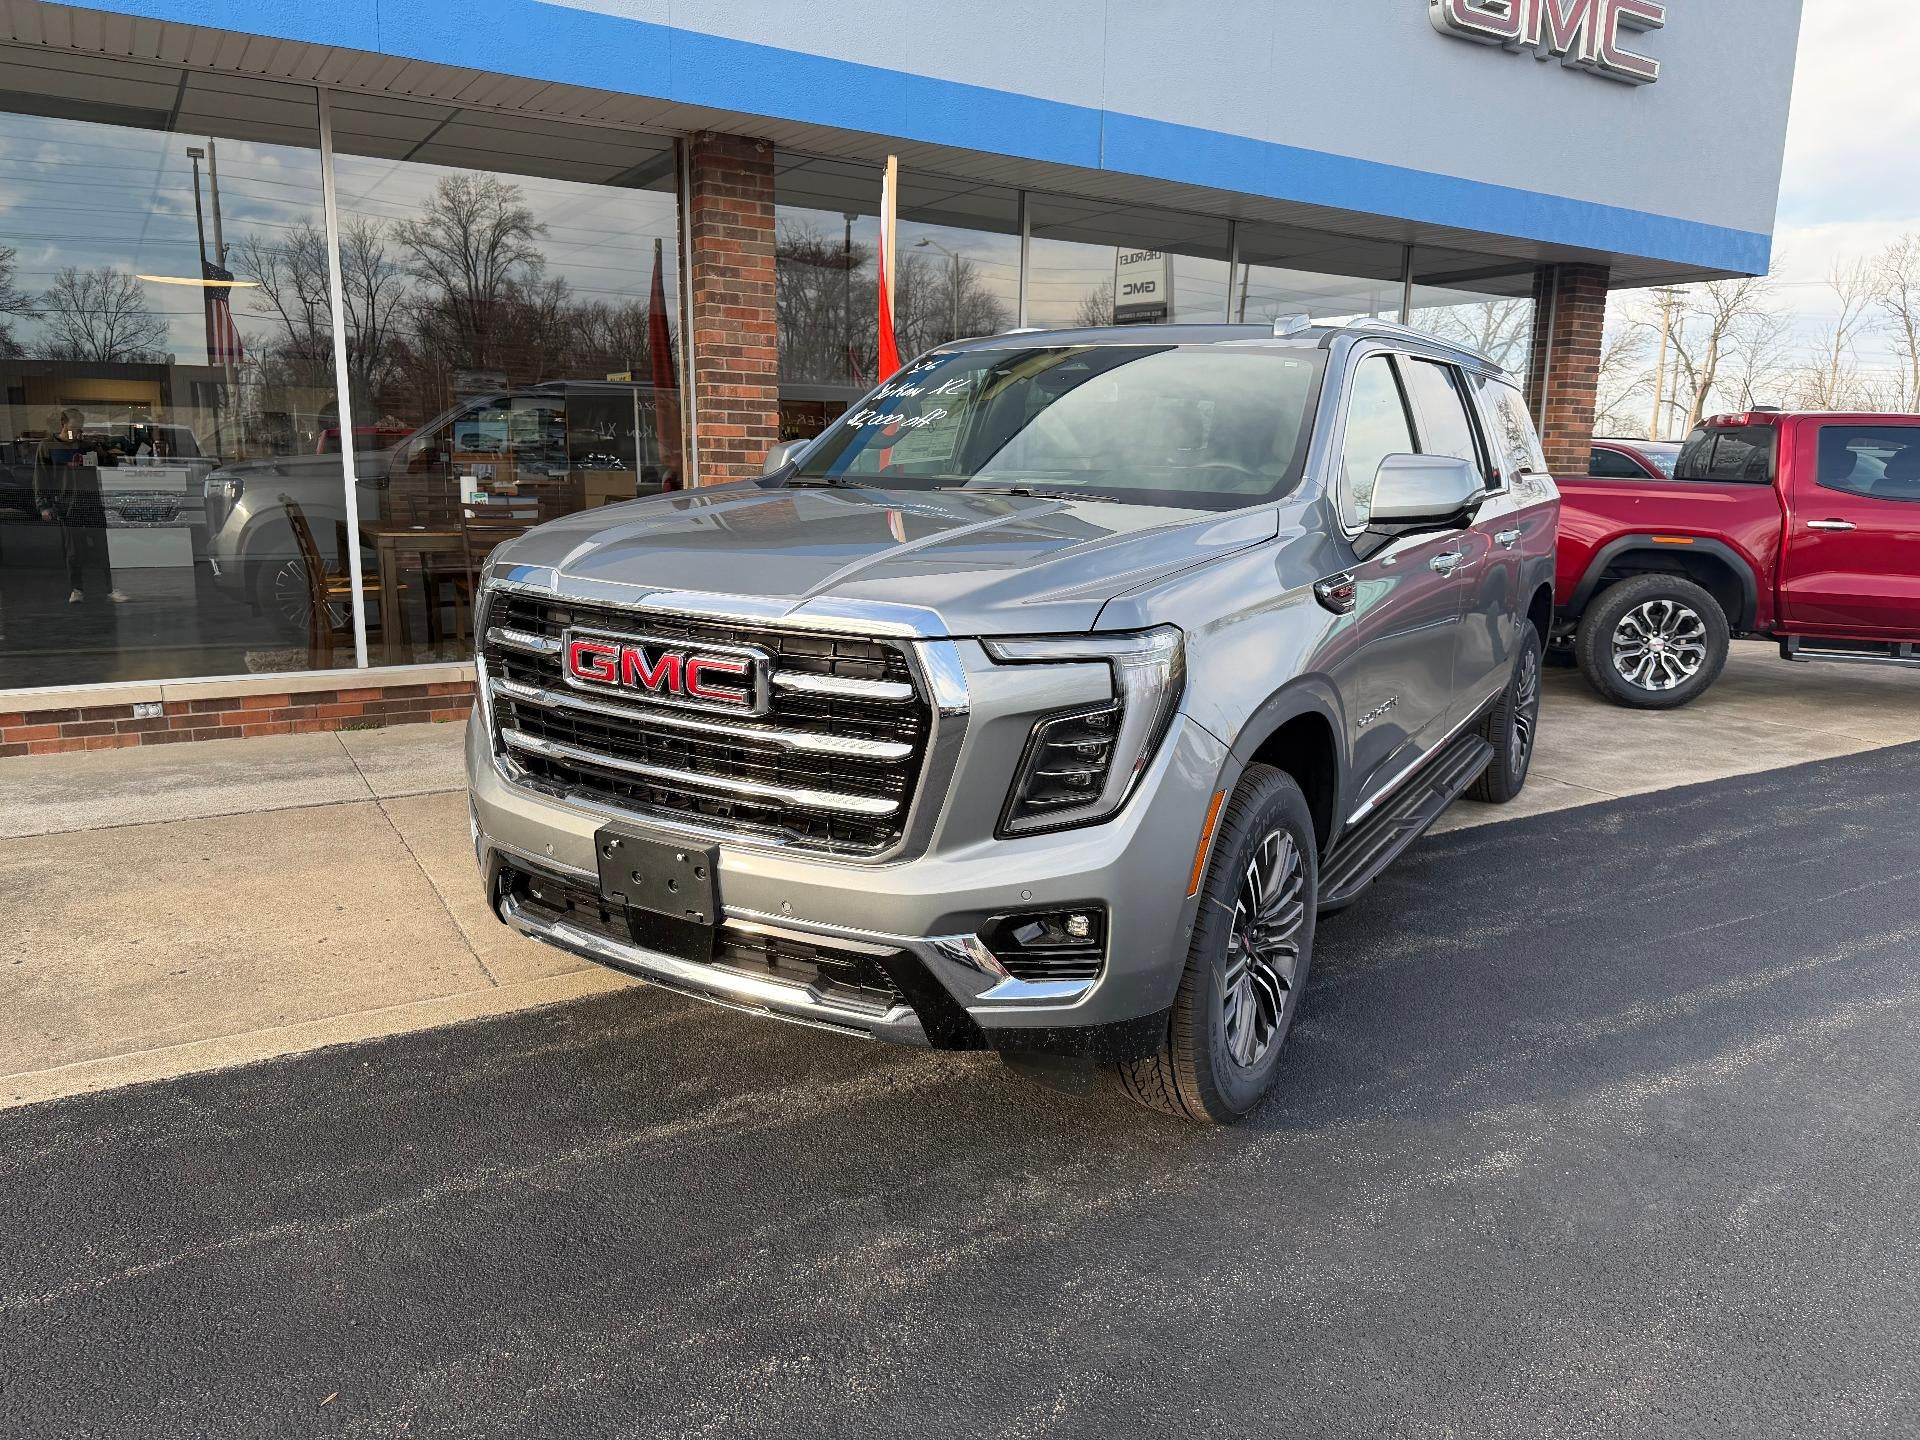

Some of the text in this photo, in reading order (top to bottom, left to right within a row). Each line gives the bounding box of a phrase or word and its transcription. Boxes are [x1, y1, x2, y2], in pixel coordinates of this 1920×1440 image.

[1436, 0, 1665, 84] GMC
[928, 379, 971, 395] XL
[570, 640, 750, 702] GMC
